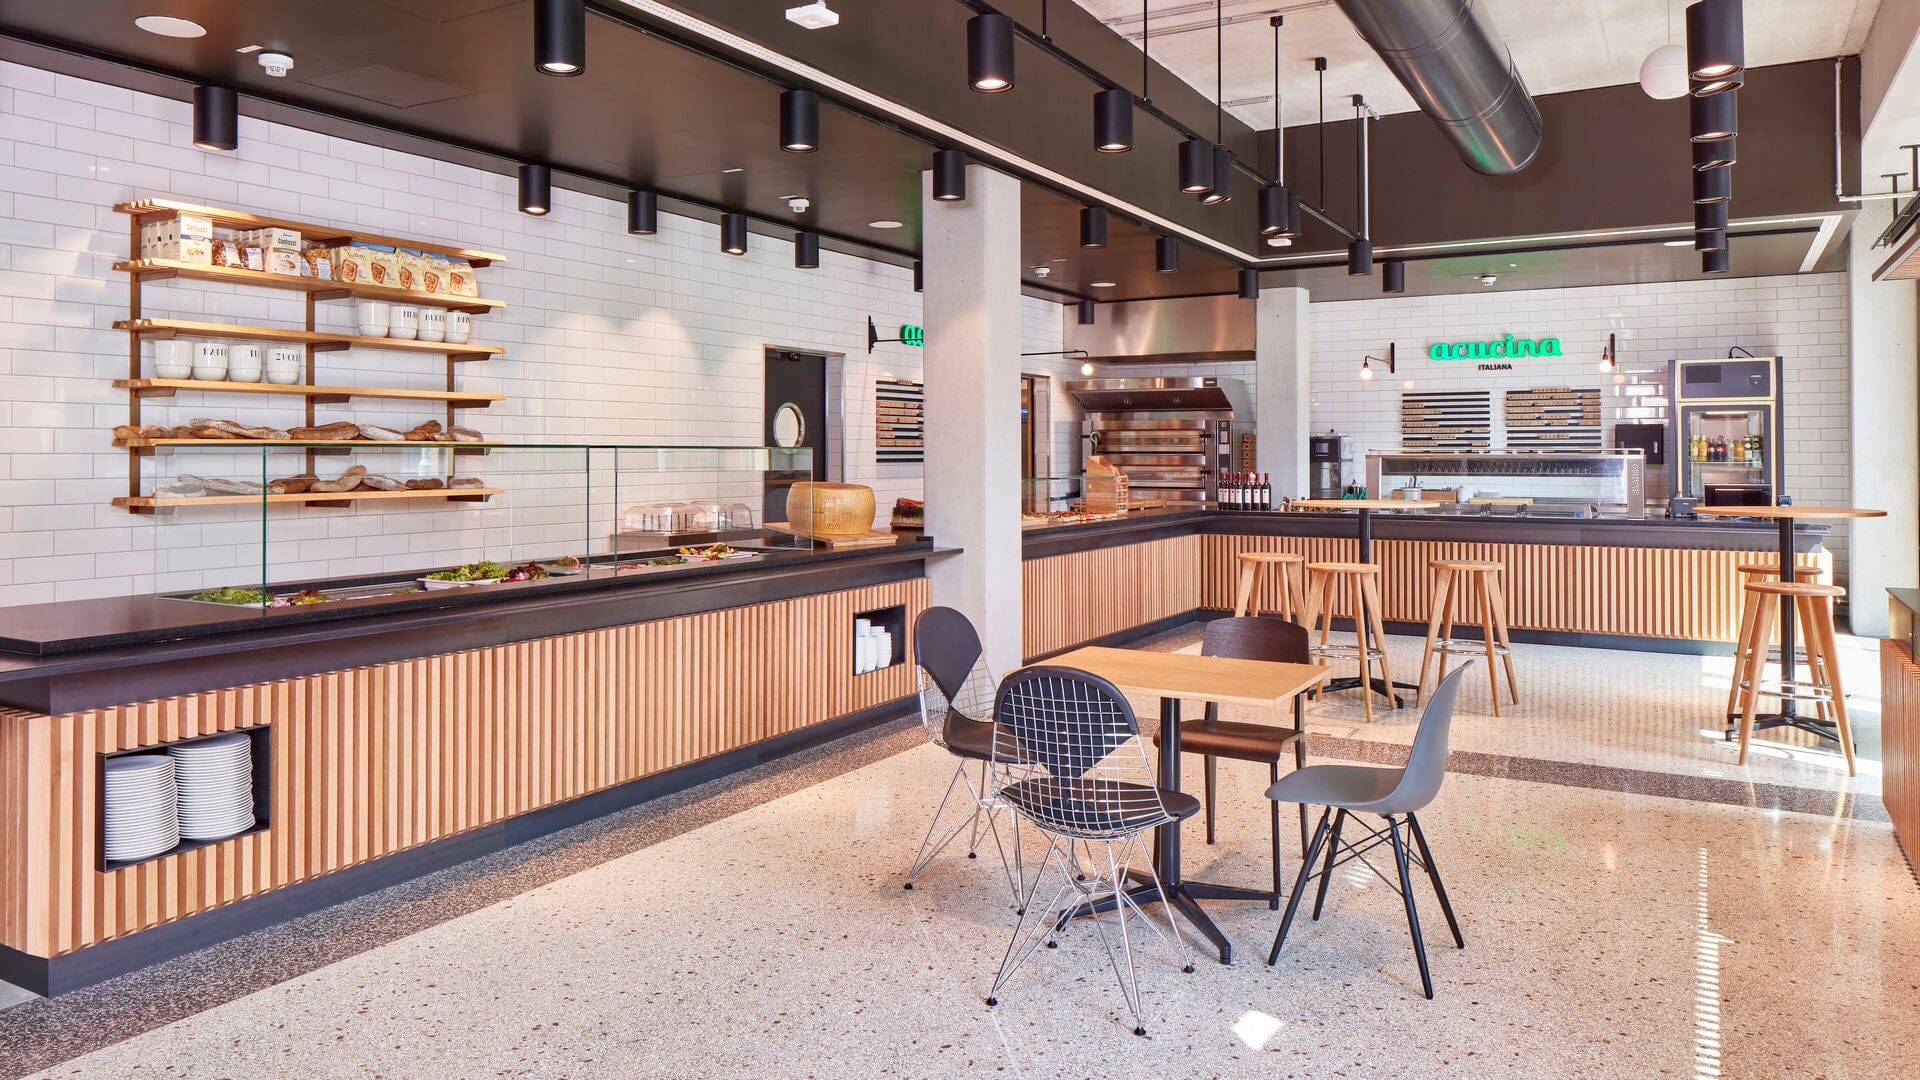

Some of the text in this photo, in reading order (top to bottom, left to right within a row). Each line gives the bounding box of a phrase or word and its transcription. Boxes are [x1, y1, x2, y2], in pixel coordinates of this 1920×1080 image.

[278, 237, 296, 247] Cantucci
[1429, 332, 1563, 361] acucina
[1478, 363, 1513, 371] ITALIANA
